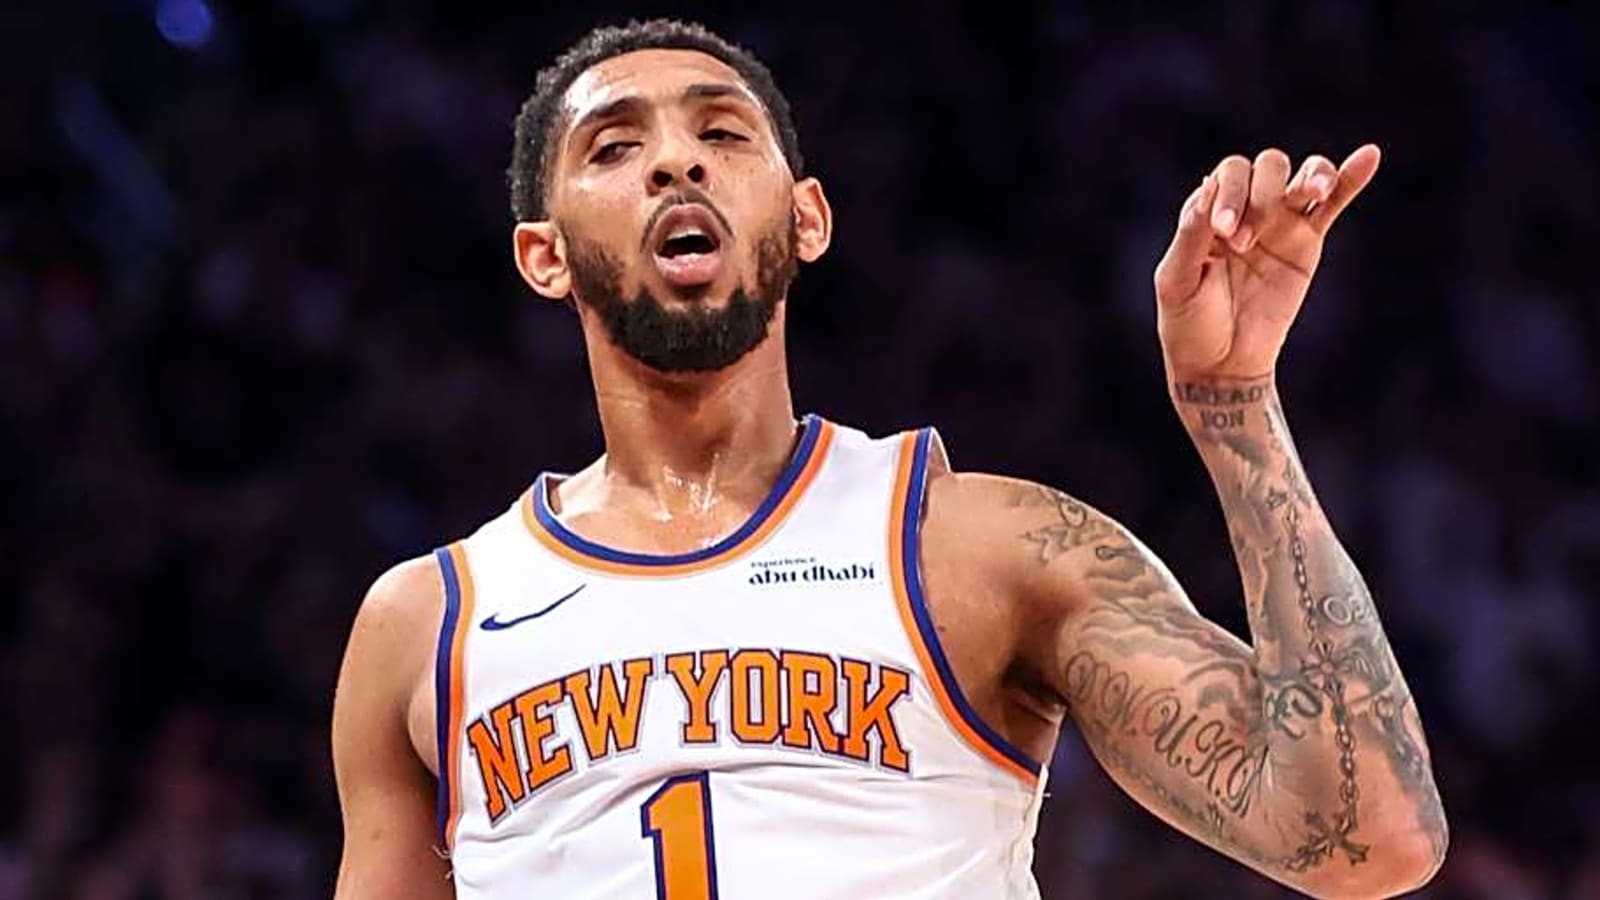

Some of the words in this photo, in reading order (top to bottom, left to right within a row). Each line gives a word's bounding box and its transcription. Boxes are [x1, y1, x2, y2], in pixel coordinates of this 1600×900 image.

[748, 569, 798, 585] abu
[801, 563, 875, 582] dhabi
[466, 656, 654, 825] NEW
[664, 647, 911, 775] YORK
[639, 769, 719, 900] 1
